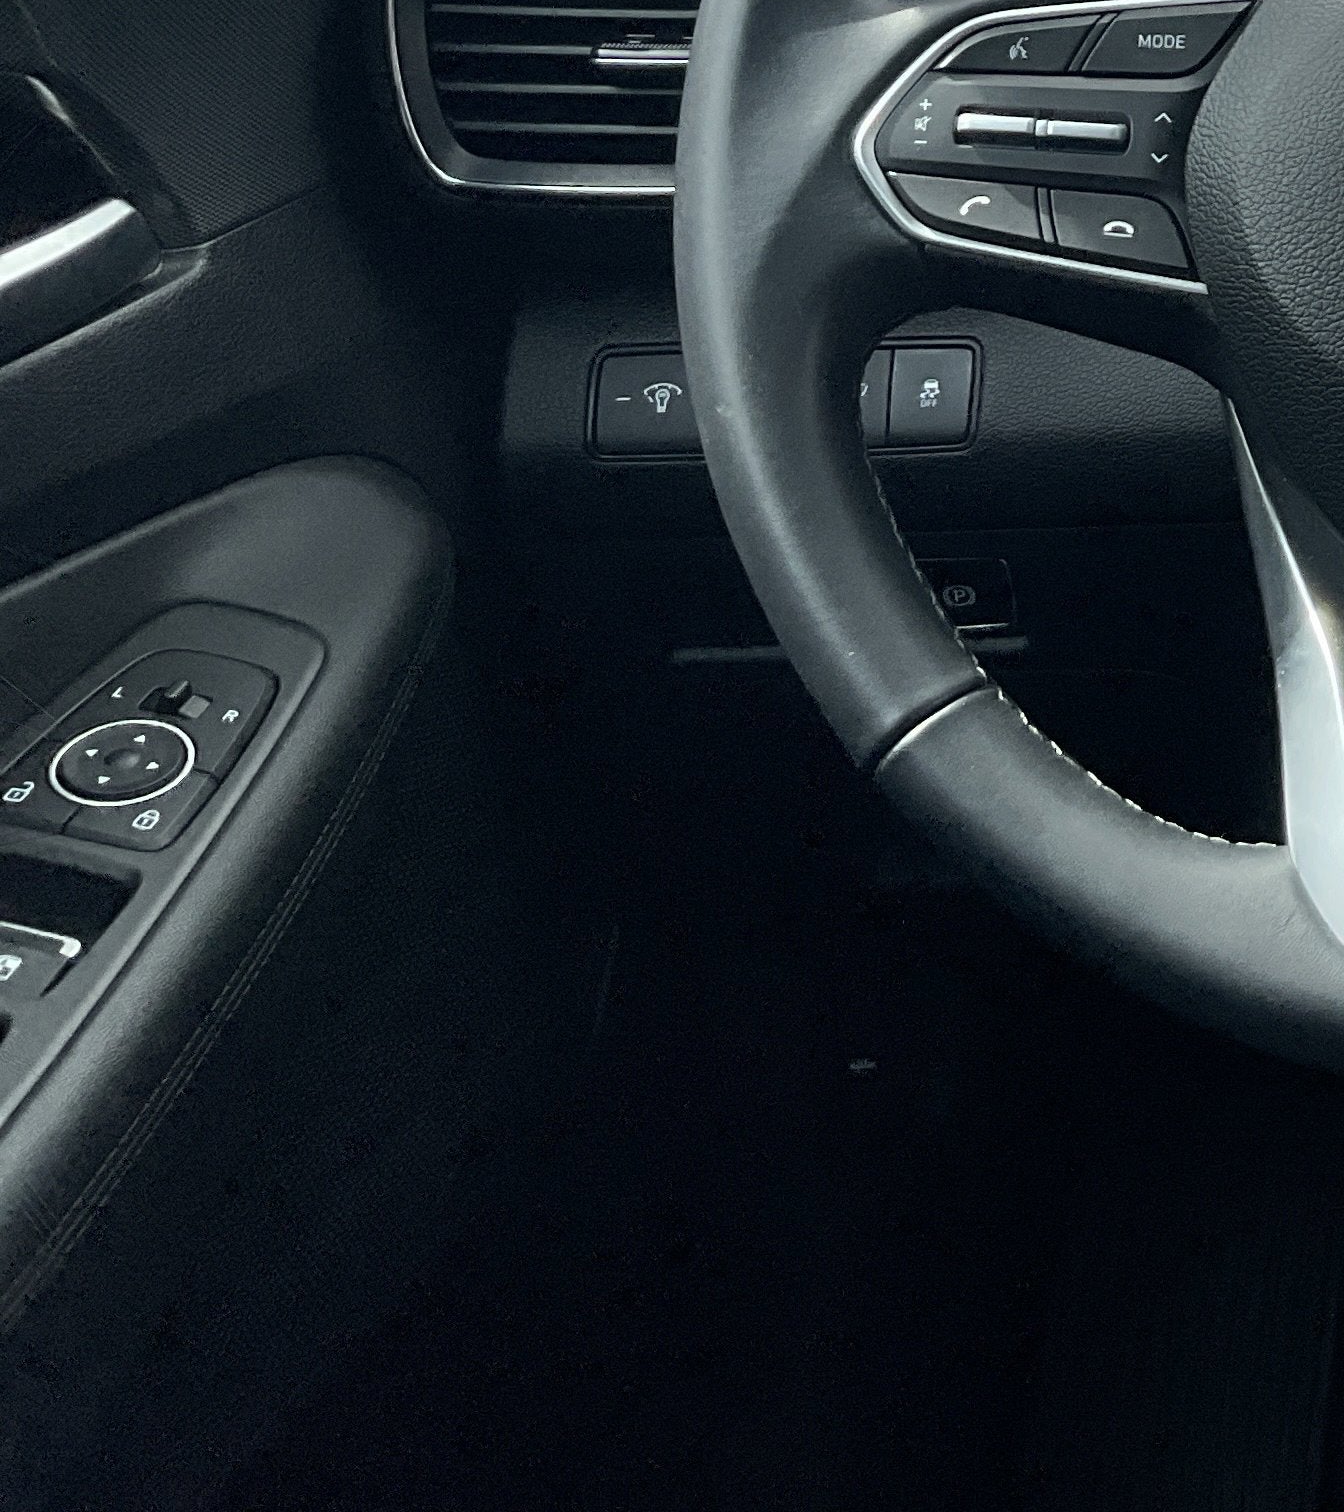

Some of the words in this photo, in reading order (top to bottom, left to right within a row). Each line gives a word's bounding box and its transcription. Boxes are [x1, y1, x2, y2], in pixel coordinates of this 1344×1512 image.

[1137, 33, 1187, 50] MODE
[111, 686, 123, 699] L
[221, 709, 240, 723] R
